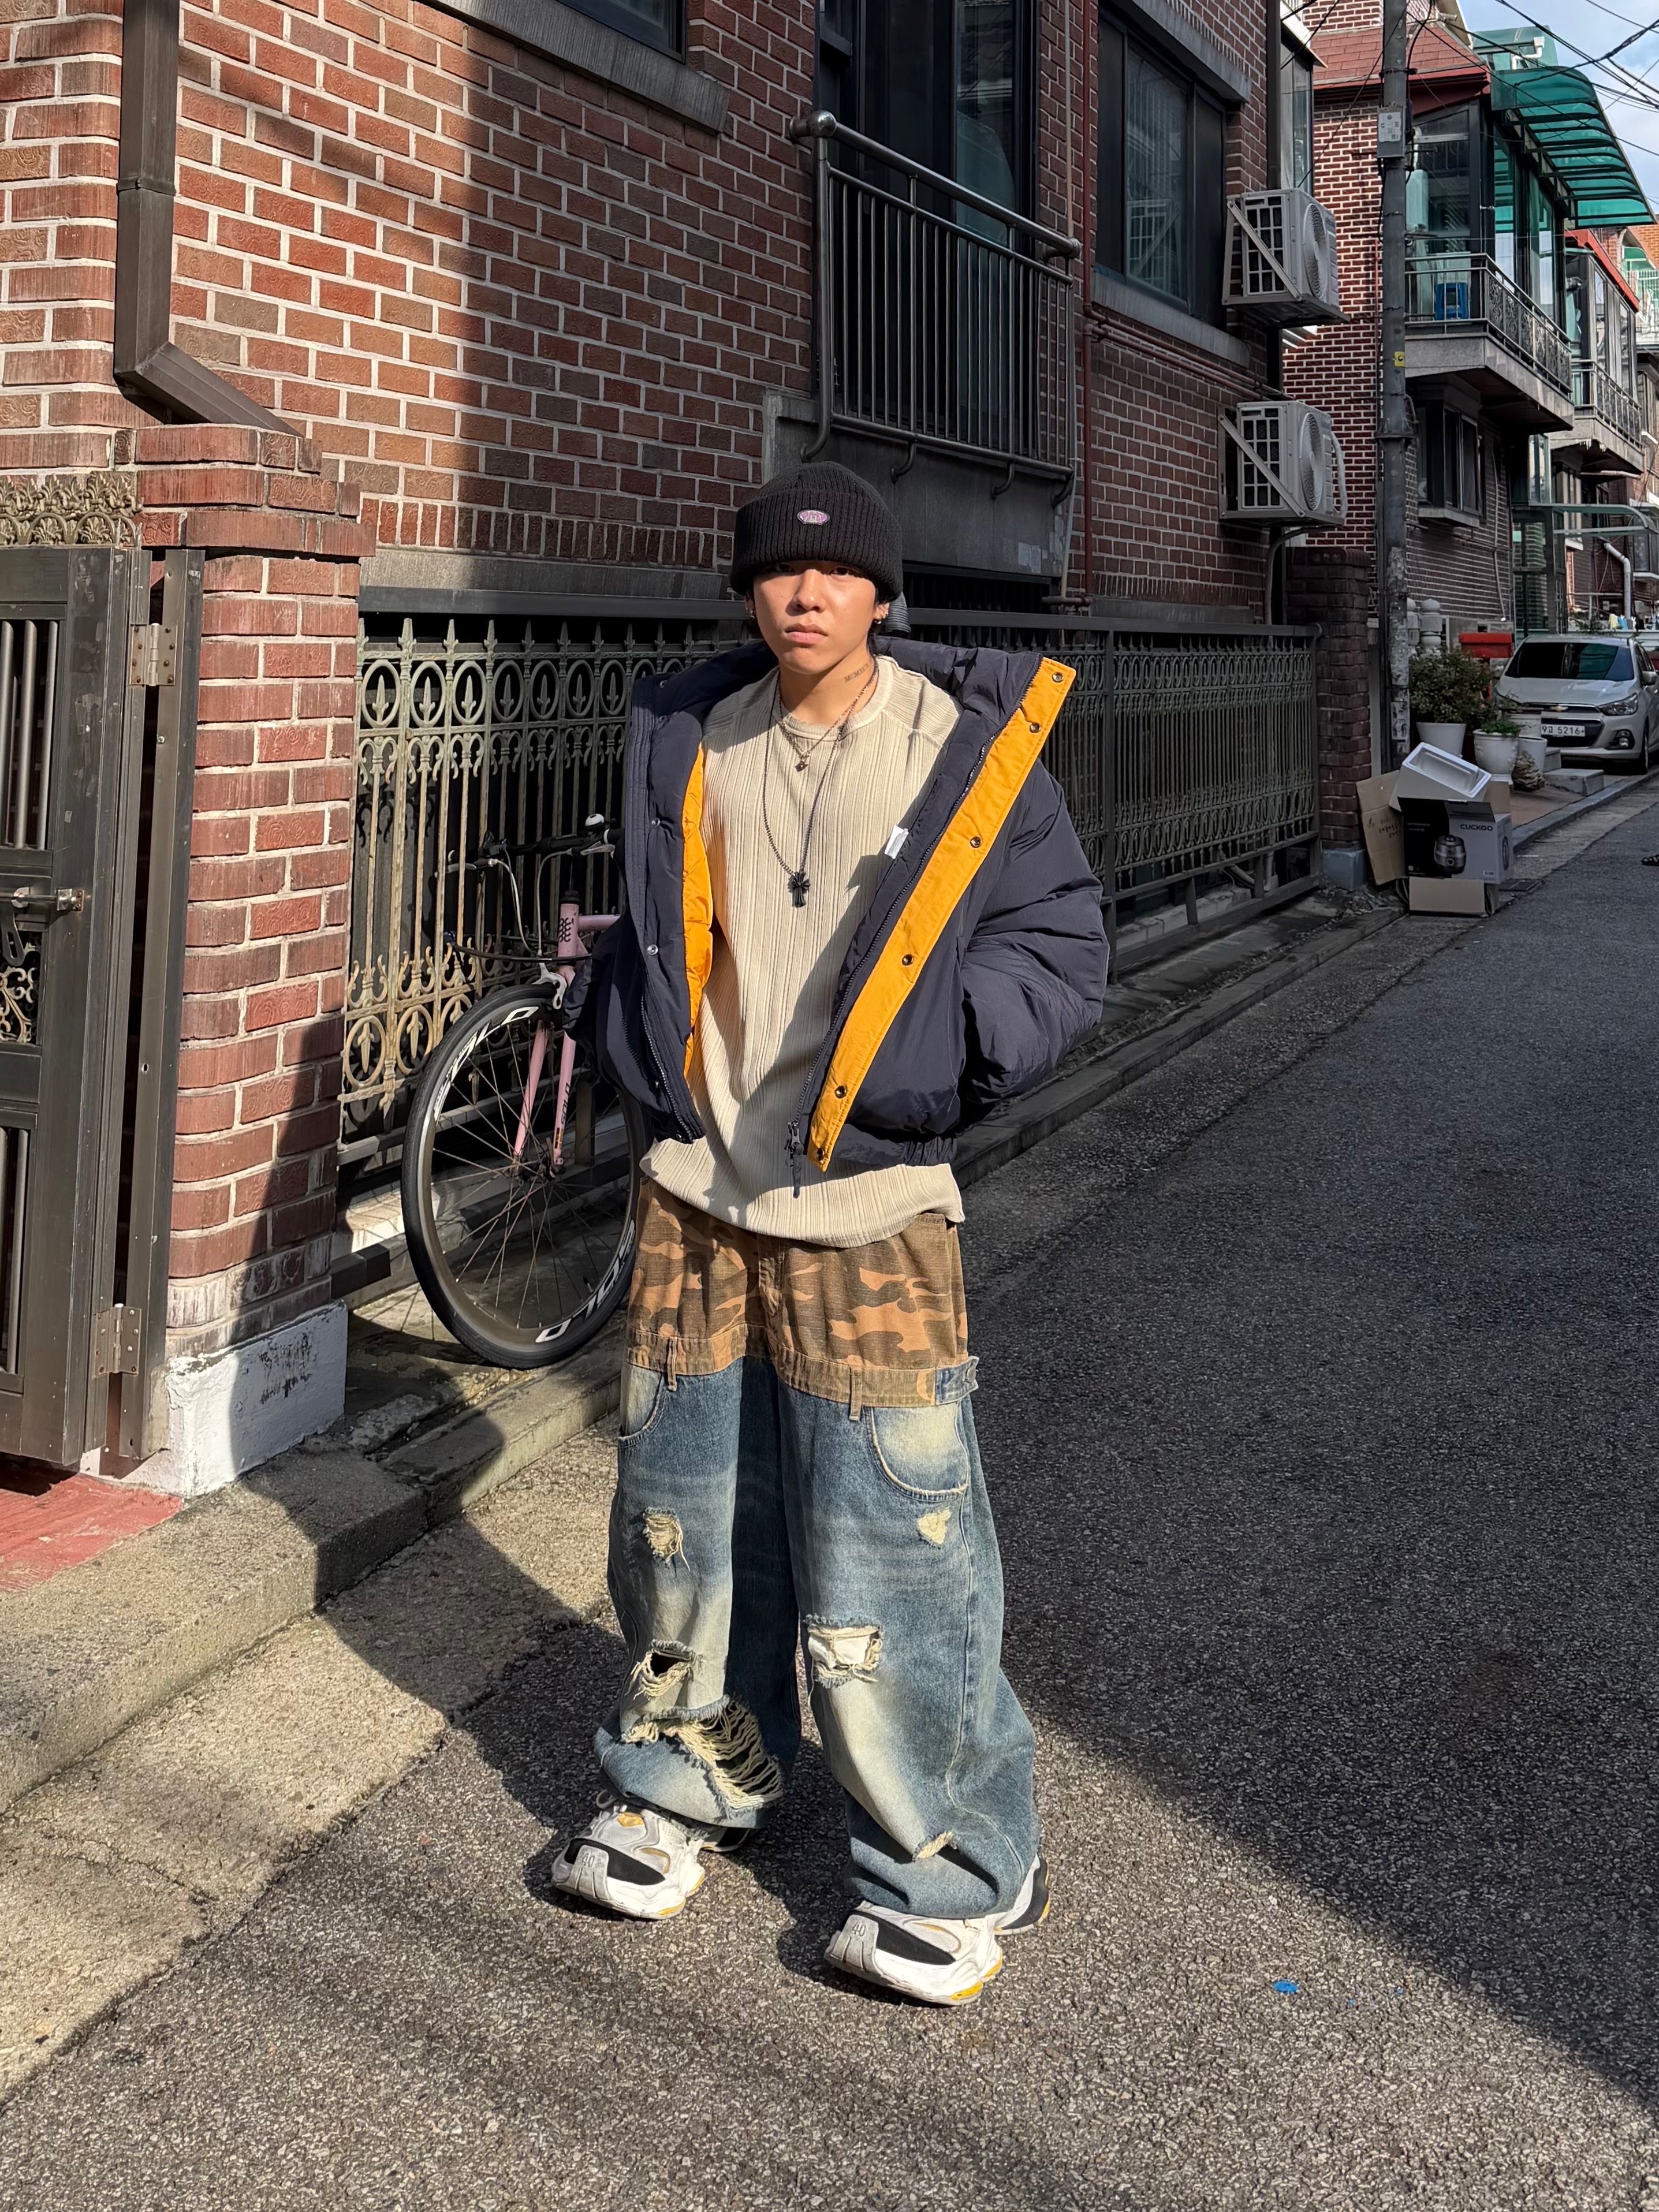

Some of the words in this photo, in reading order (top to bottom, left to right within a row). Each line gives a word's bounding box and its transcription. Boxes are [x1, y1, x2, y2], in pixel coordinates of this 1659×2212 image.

[1557, 726, 1580, 734] 5216
[1460, 823, 1493, 831] CUCKOO
[561, 1082, 571, 1125] SOLO
[581, 1852, 595, 1867] 40
[852, 1922, 866, 1937] 40
